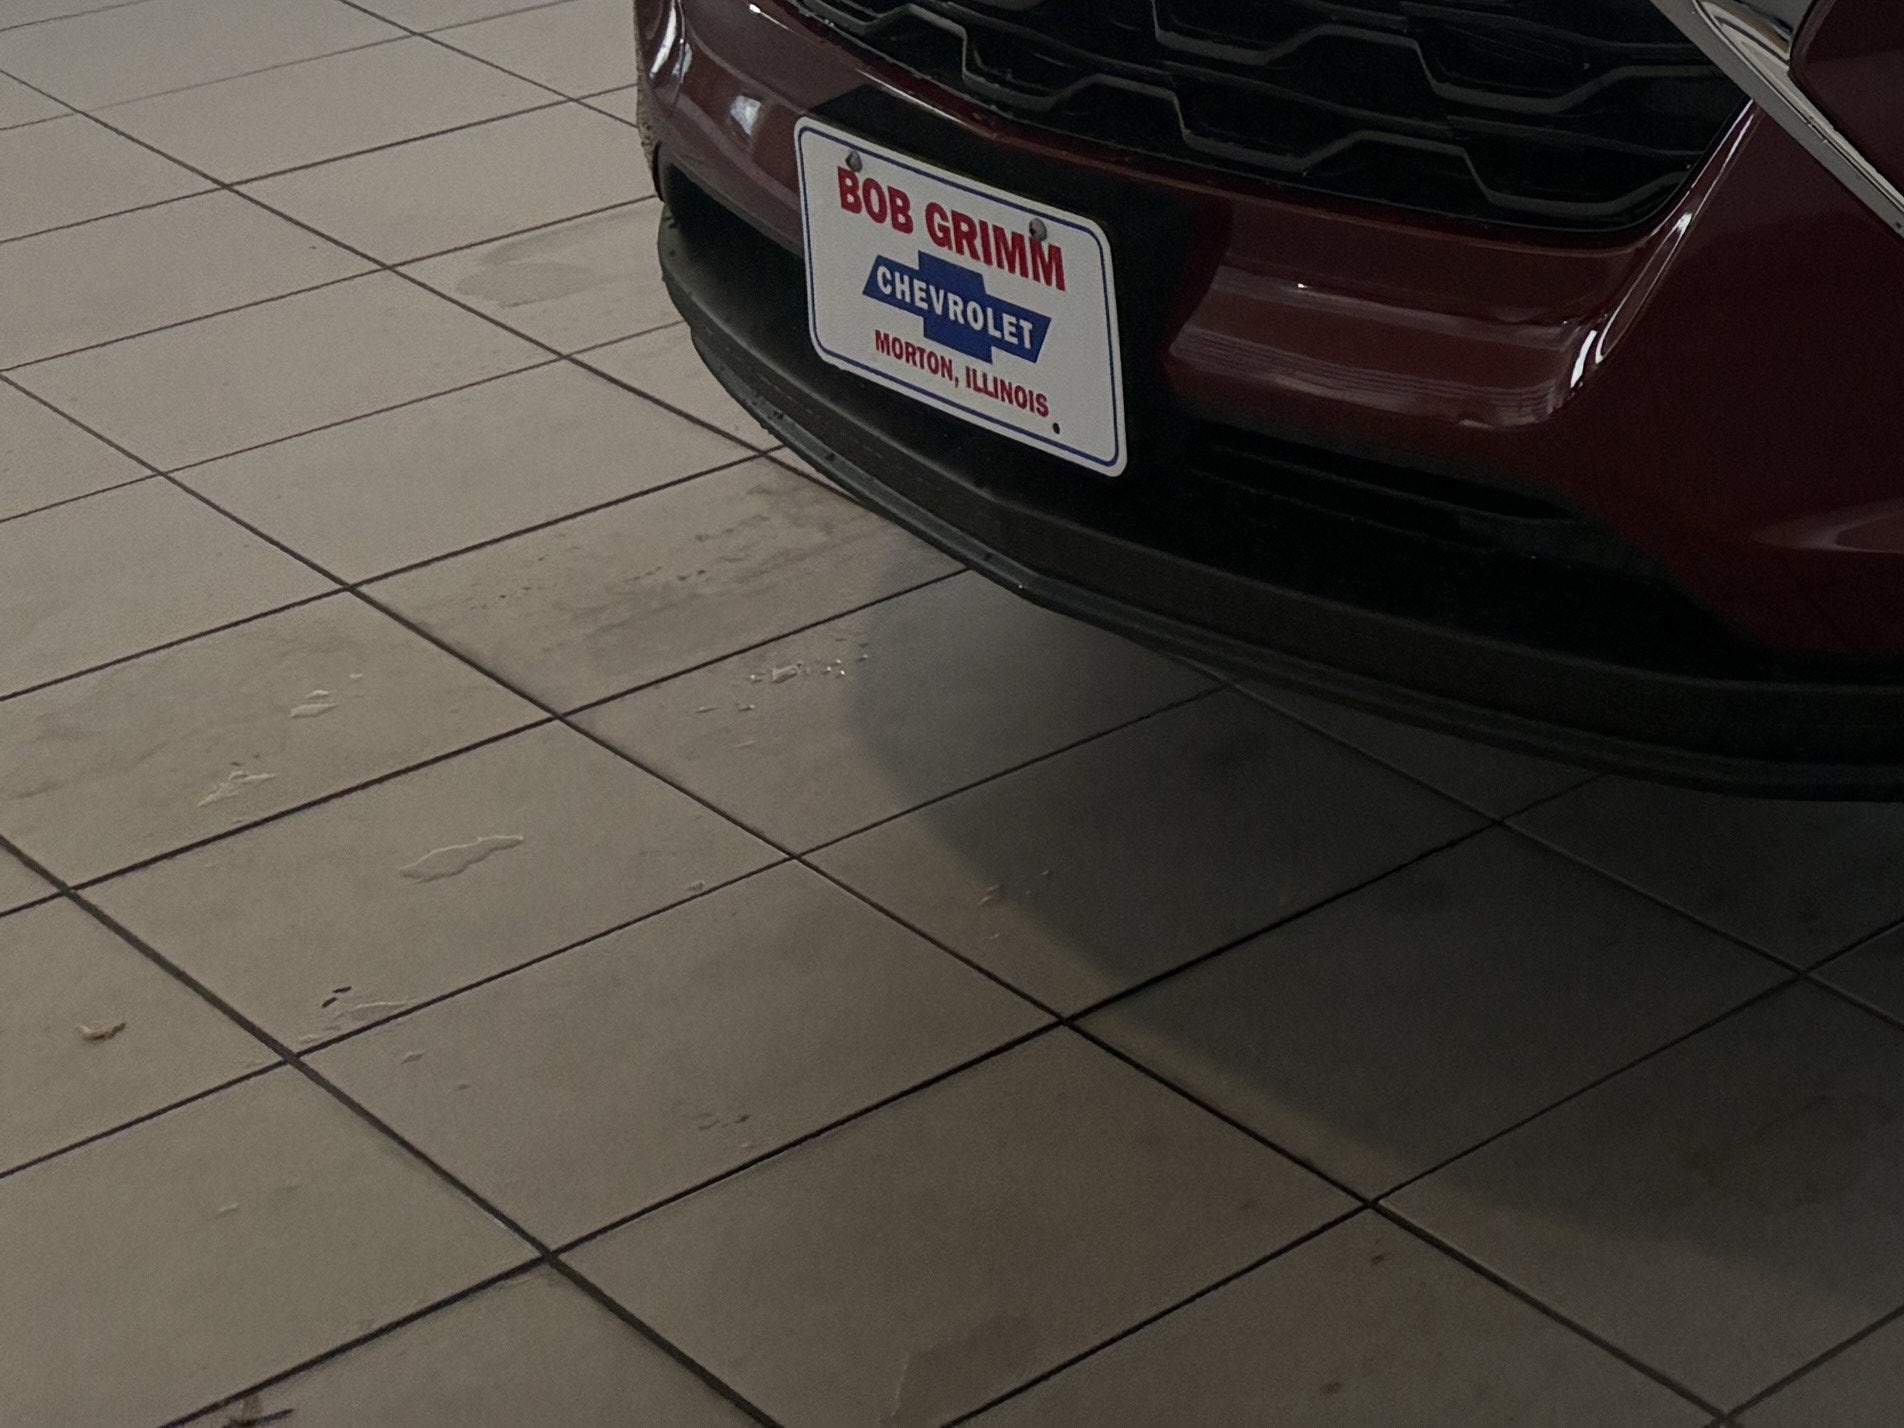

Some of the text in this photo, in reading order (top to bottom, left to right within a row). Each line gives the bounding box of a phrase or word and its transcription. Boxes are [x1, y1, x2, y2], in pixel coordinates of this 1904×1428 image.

[836, 166, 1066, 292] BOB GRIMM
[875, 264, 1034, 351] CHEVROLET
[873, 328, 1050, 419] MORTON, ILLINOIS
